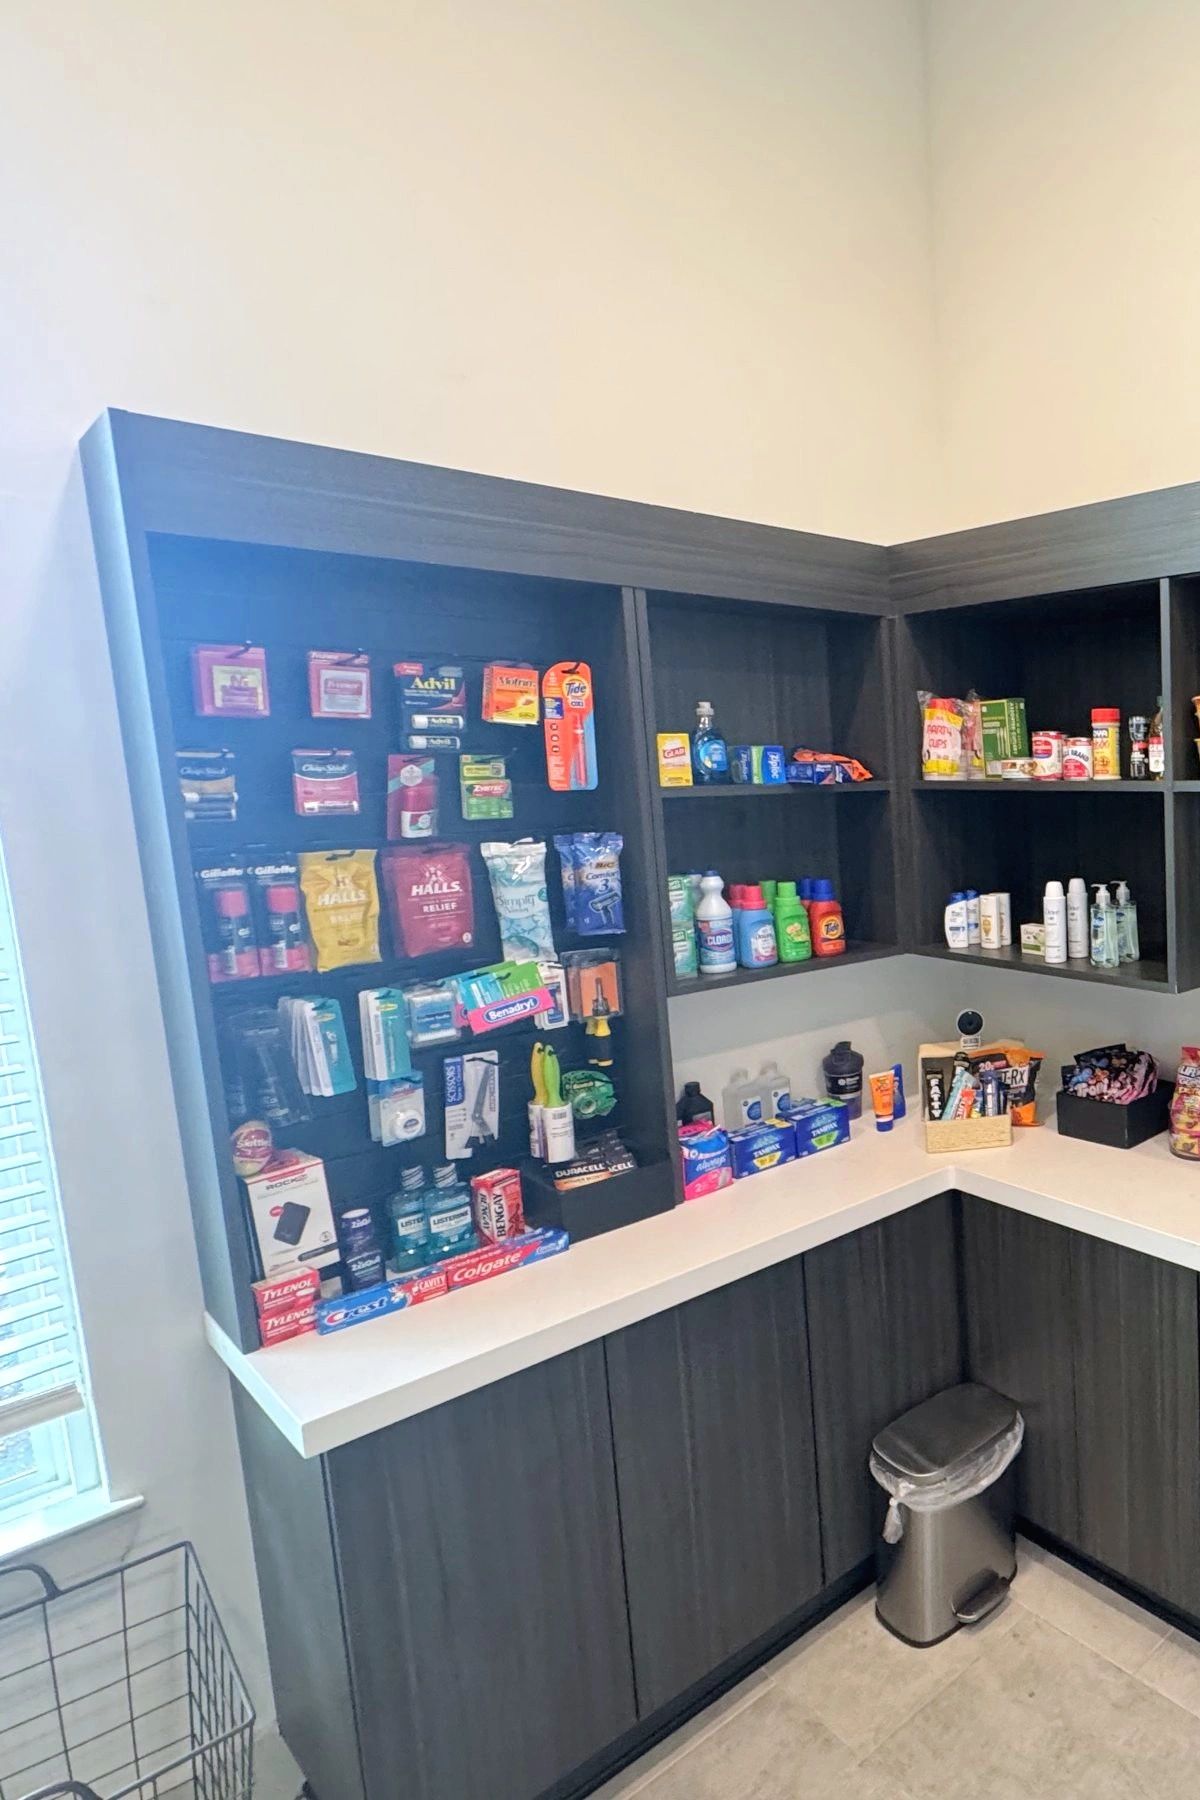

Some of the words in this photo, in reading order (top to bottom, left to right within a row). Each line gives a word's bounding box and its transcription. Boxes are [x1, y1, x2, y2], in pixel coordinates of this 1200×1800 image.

[411, 677, 456, 691] Advil
[565, 682, 586, 695] Tide
[665, 747, 686, 758] GLAD
[767, 750, 780, 780] Ziploc
[201, 868, 243, 879] Gillette
[255, 866, 296, 876] Gillette
[411, 880, 460, 897] HALLS
[318, 890, 368, 906] HALLS
[423, 902, 457, 913] RELIEF
[488, 998, 536, 1021] Benadryl
[447, 1064, 457, 1103] SCISSORS
[930, 1078, 942, 1118] FATTY
[811, 1122, 838, 1137] TAMPAX
[555, 1163, 605, 1178] DURACELL
[433, 1212, 469, 1226] LISTERINE
[493, 1192, 503, 1238] BENGAY
[453, 1252, 521, 1283] Colgate
[263, 1278, 313, 1301] TYLENOL
[419, 1275, 446, 1292] CAVITY
[326, 1296, 388, 1325] Crest
